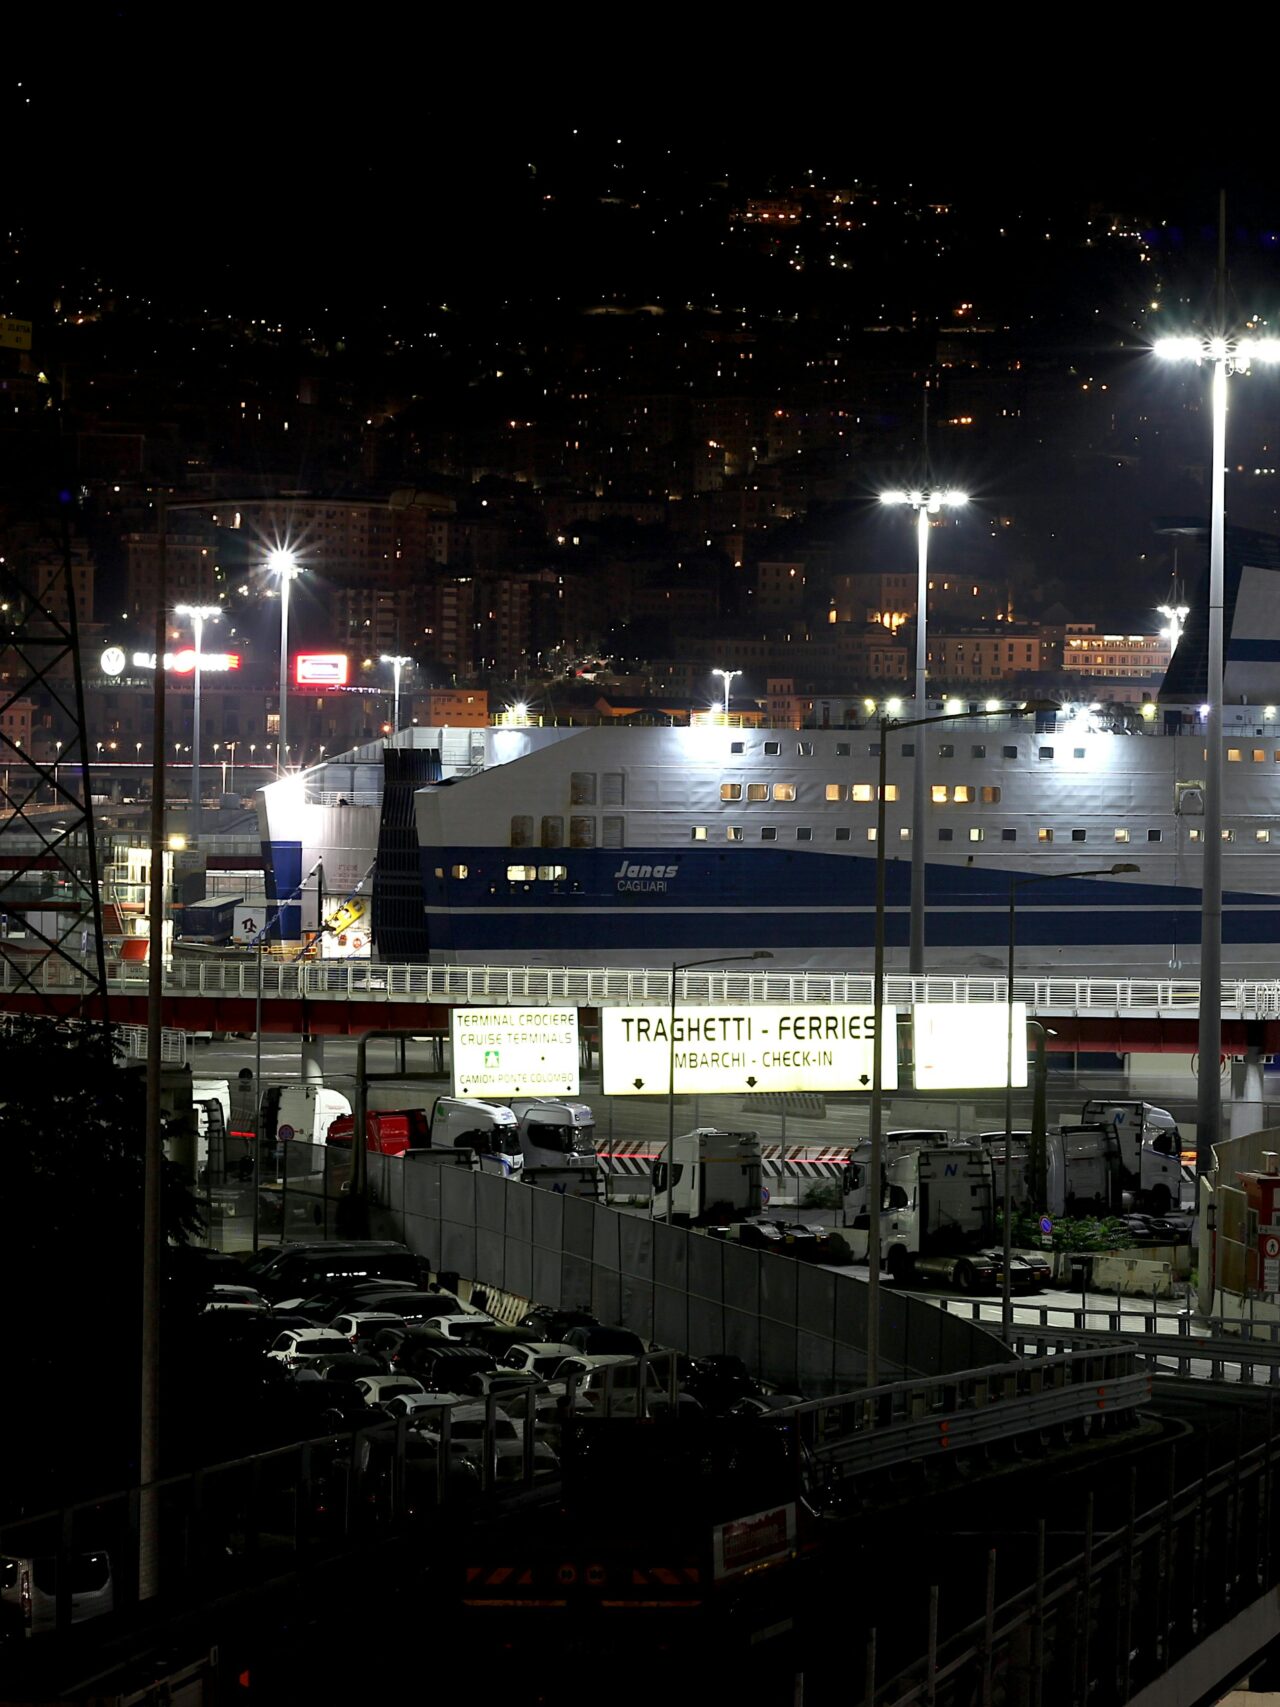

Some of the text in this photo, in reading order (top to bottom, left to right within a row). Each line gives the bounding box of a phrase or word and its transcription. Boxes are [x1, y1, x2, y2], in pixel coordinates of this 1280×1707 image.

[614, 861, 679, 878] Janas
[617, 881, 668, 892] CAGLIARI
[457, 1013, 575, 1027] TERMINAL CROCIERE
[621, 1017, 751, 1042] TRAGHETTI
[778, 1016, 876, 1040] FERRIES
[460, 1032, 572, 1045] CRUISE TERMINALS
[671, 1052, 746, 1069] MBARCHI
[762, 1051, 833, 1067] CHECK-IN
[459, 1074, 495, 1084] CAMION
